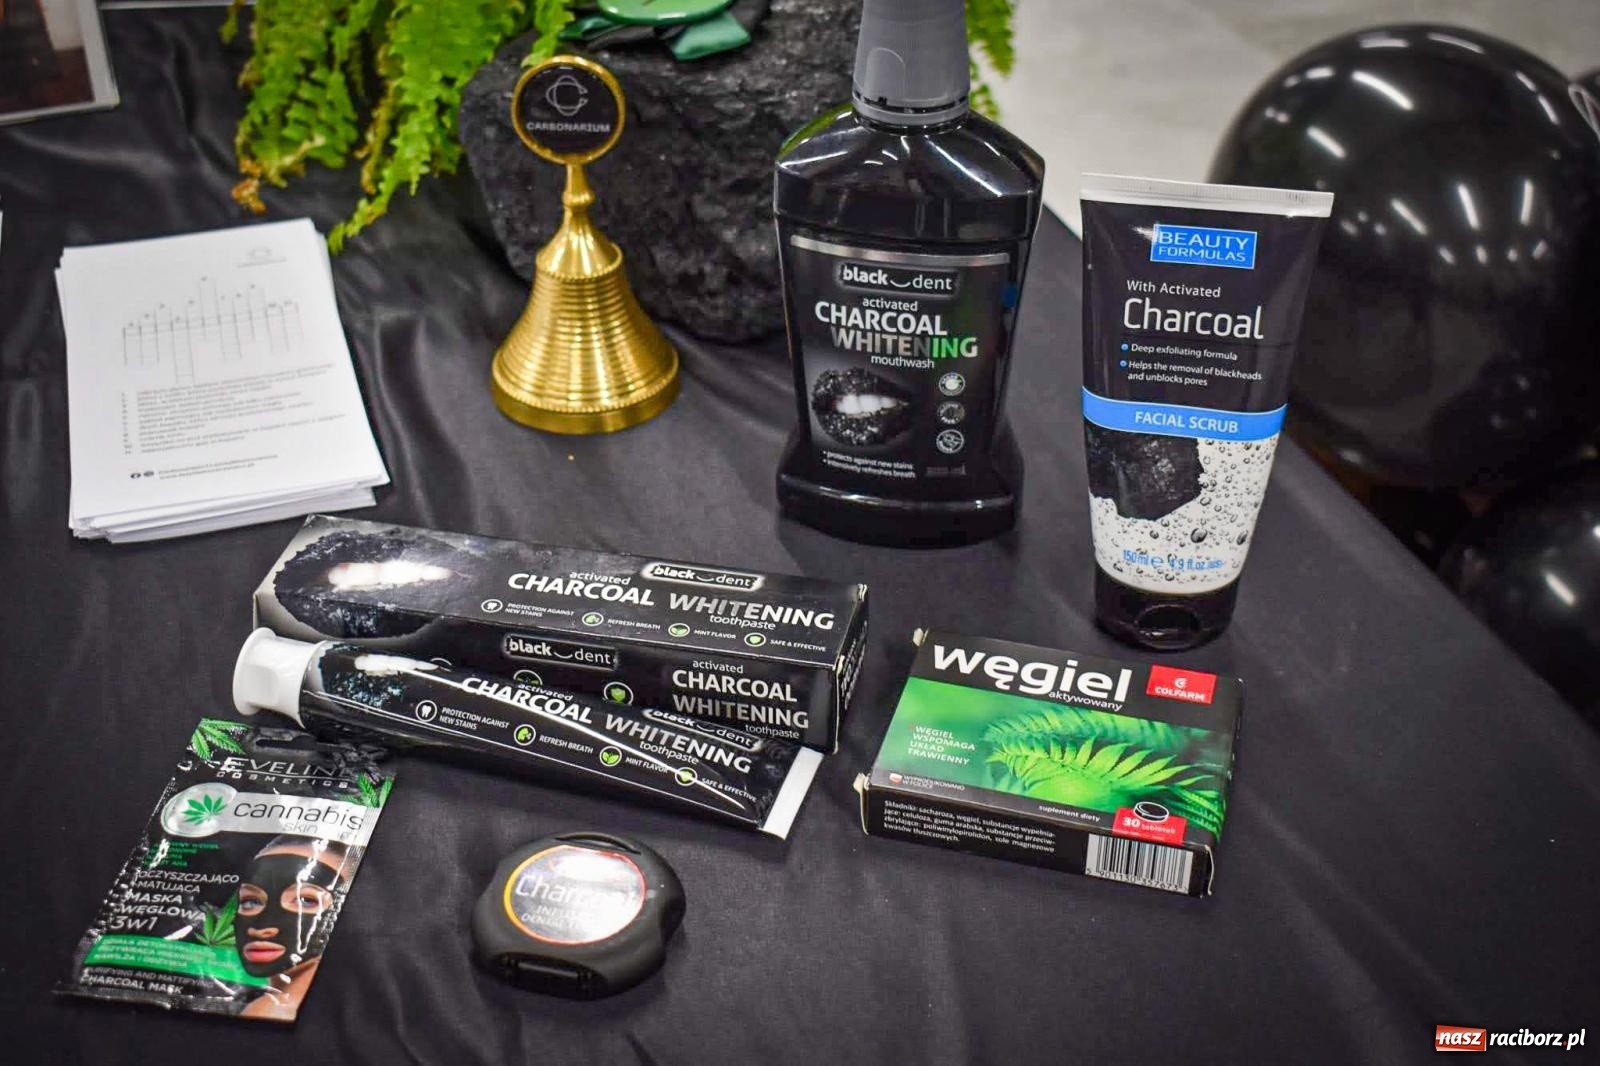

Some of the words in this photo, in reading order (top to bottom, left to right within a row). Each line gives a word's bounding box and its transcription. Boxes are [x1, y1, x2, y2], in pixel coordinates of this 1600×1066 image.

[526, 121, 610, 132] CARBONARIUM
[1157, 231, 1249, 250] BEAUTY
[1158, 245, 1246, 262] FORMULAS
[843, 265, 888, 286] black
[912, 275, 952, 290] dent
[1127, 279, 1156, 292] With
[1160, 282, 1221, 297] Activated
[862, 297, 918, 312] activated
[814, 301, 948, 336] CHARCOAL
[1123, 297, 1264, 340] Charcoal
[830, 326, 978, 358] WHITENING
[1131, 343, 1154, 354] Deep
[1156, 345, 1202, 359] exfoliating
[1203, 349, 1238, 360] formula
[870, 355, 935, 369] mouthwash
[1128, 360, 1152, 371] Helps
[1154, 361, 1167, 371] the
[1169, 362, 1203, 375] removal
[1204, 365, 1213, 375] of
[1214, 367, 1262, 380] blackheads
[1127, 371, 1144, 380] and
[1145, 372, 1182, 384] unblocks
[1184, 376, 1208, 387] pores
[1135, 411, 1185, 428] FACIAL
[1189, 414, 1238, 433] SCRUB
[570, 570, 630, 586] activated
[654, 565, 694, 580] black
[715, 573, 750, 587] dent
[507, 602, 546, 612] PROTECTION
[547, 608, 574, 616] AGAINST
[508, 573, 655, 606] CHARCOAL
[669, 592, 835, 630] WHITENING
[520, 610, 542, 618] STAINS
[710, 614, 776, 631] toothpaste
[608, 618, 634, 626] REFRESH
[635, 622, 660, 630] BREATH
[711, 631, 736, 640] FLAVOR
[509, 638, 551, 656] black
[574, 648, 611, 664] dent
[793, 642, 826, 652] EFFECTIVE
[693, 660, 744, 674] activated
[933, 644, 1132, 703] węgiel
[518, 682, 574, 700] activated
[672, 669, 797, 702] CHARCOAL
[1154, 686, 1206, 700] COLFARM
[1048, 689, 1123, 712] aktywowany
[442, 707, 480, 723] PROTECTION
[481, 716, 510, 730] AGAINST
[672, 694, 809, 728] WHITENING
[440, 715, 454, 726] NEW
[455, 719, 478, 730] STAINS
[460, 678, 592, 724] CHARCOAL
[605, 714, 752, 774] WHITENING
[745, 723, 800, 740] toothpaste
[539, 734, 568, 748] REFRESH
[568, 741, 594, 754] BREATH
[716, 728, 752, 746] dent
[913, 732, 976, 750] WSPOMAGA
[640, 740, 700, 766] toothpaste
[907, 747, 970, 765] TRAWIENNY
[625, 756, 642, 767] MINT
[643, 761, 670, 774] FLAVOR
[216, 771, 349, 789] COSMETICS
[702, 777, 718, 788] SAFE
[724, 784, 758, 802] EFFECTIVE
[234, 801, 364, 830] cannabis
[919, 807, 954, 819] sacharoza,
[982, 818, 1020, 832] substancje
[1039, 804, 1079, 818] suplement
[1080, 812, 1100, 823] diety
[902, 811, 932, 822] celuloza,
[934, 817, 954, 827] guma
[955, 820, 984, 832] arabska,
[986, 826, 1024, 840] substancje
[1123, 816, 1140, 828] 30
[1141, 824, 1176, 834] tabletek
[138, 869, 240, 884] OCZYSZCZAJĄCO
[127, 892, 182, 904] MASKA
